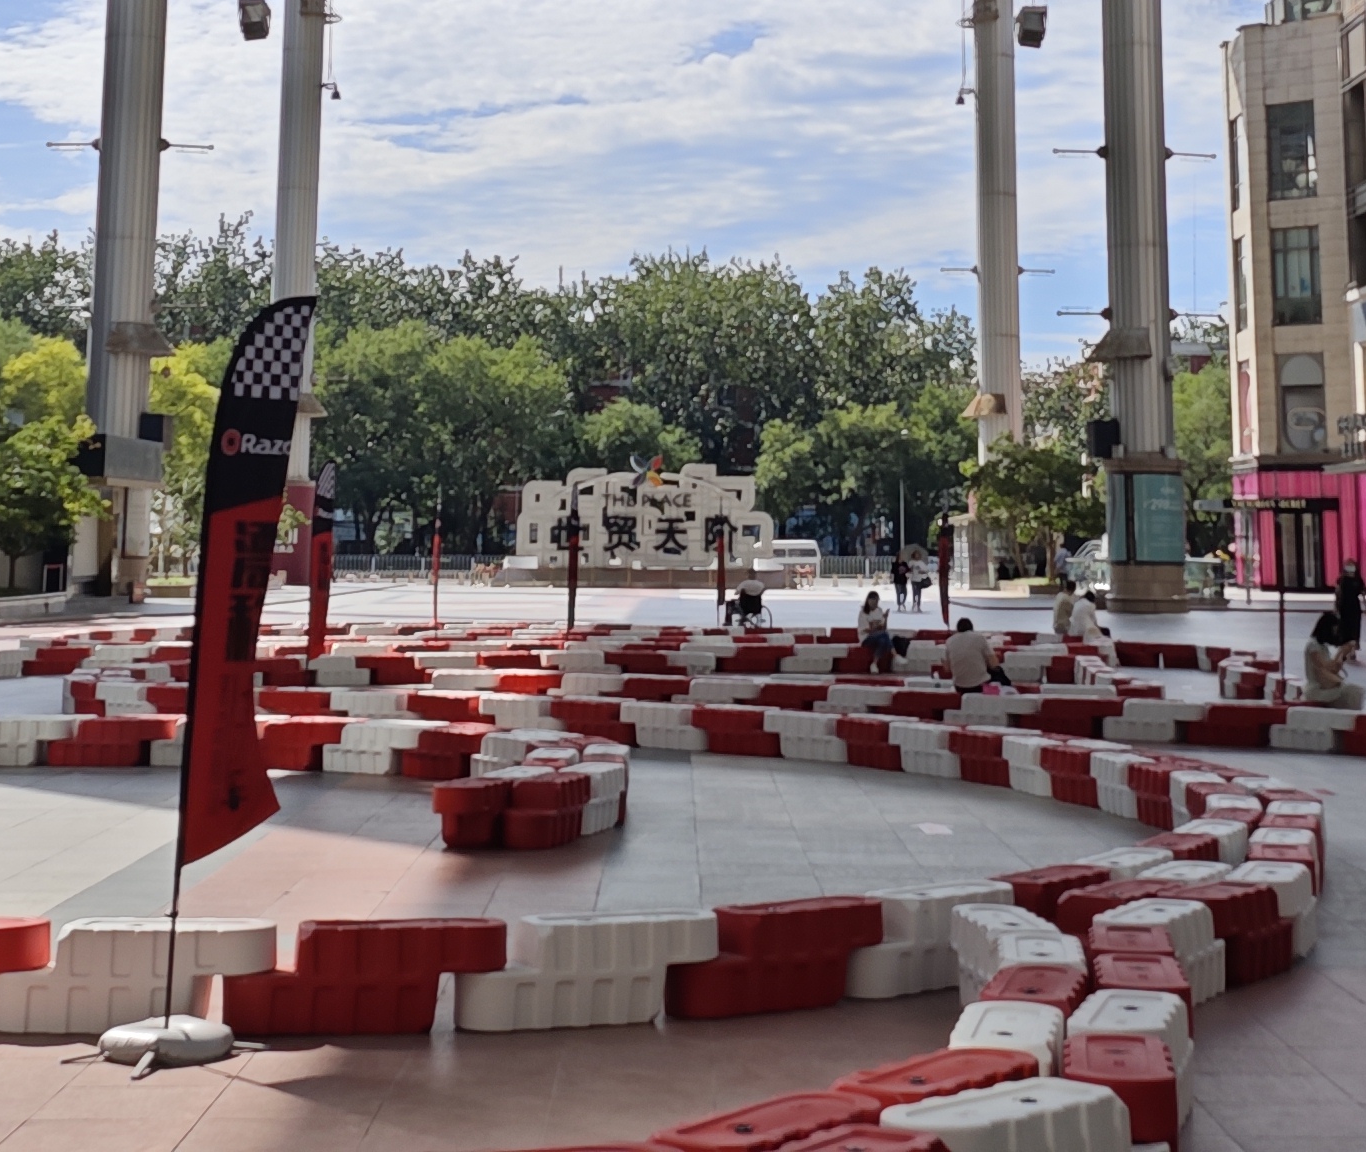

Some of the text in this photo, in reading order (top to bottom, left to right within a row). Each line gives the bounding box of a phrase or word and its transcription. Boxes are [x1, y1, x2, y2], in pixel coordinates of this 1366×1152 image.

[602, 493, 692, 508] THE PLACE
[551, 515, 738, 553] 世贸天阶
